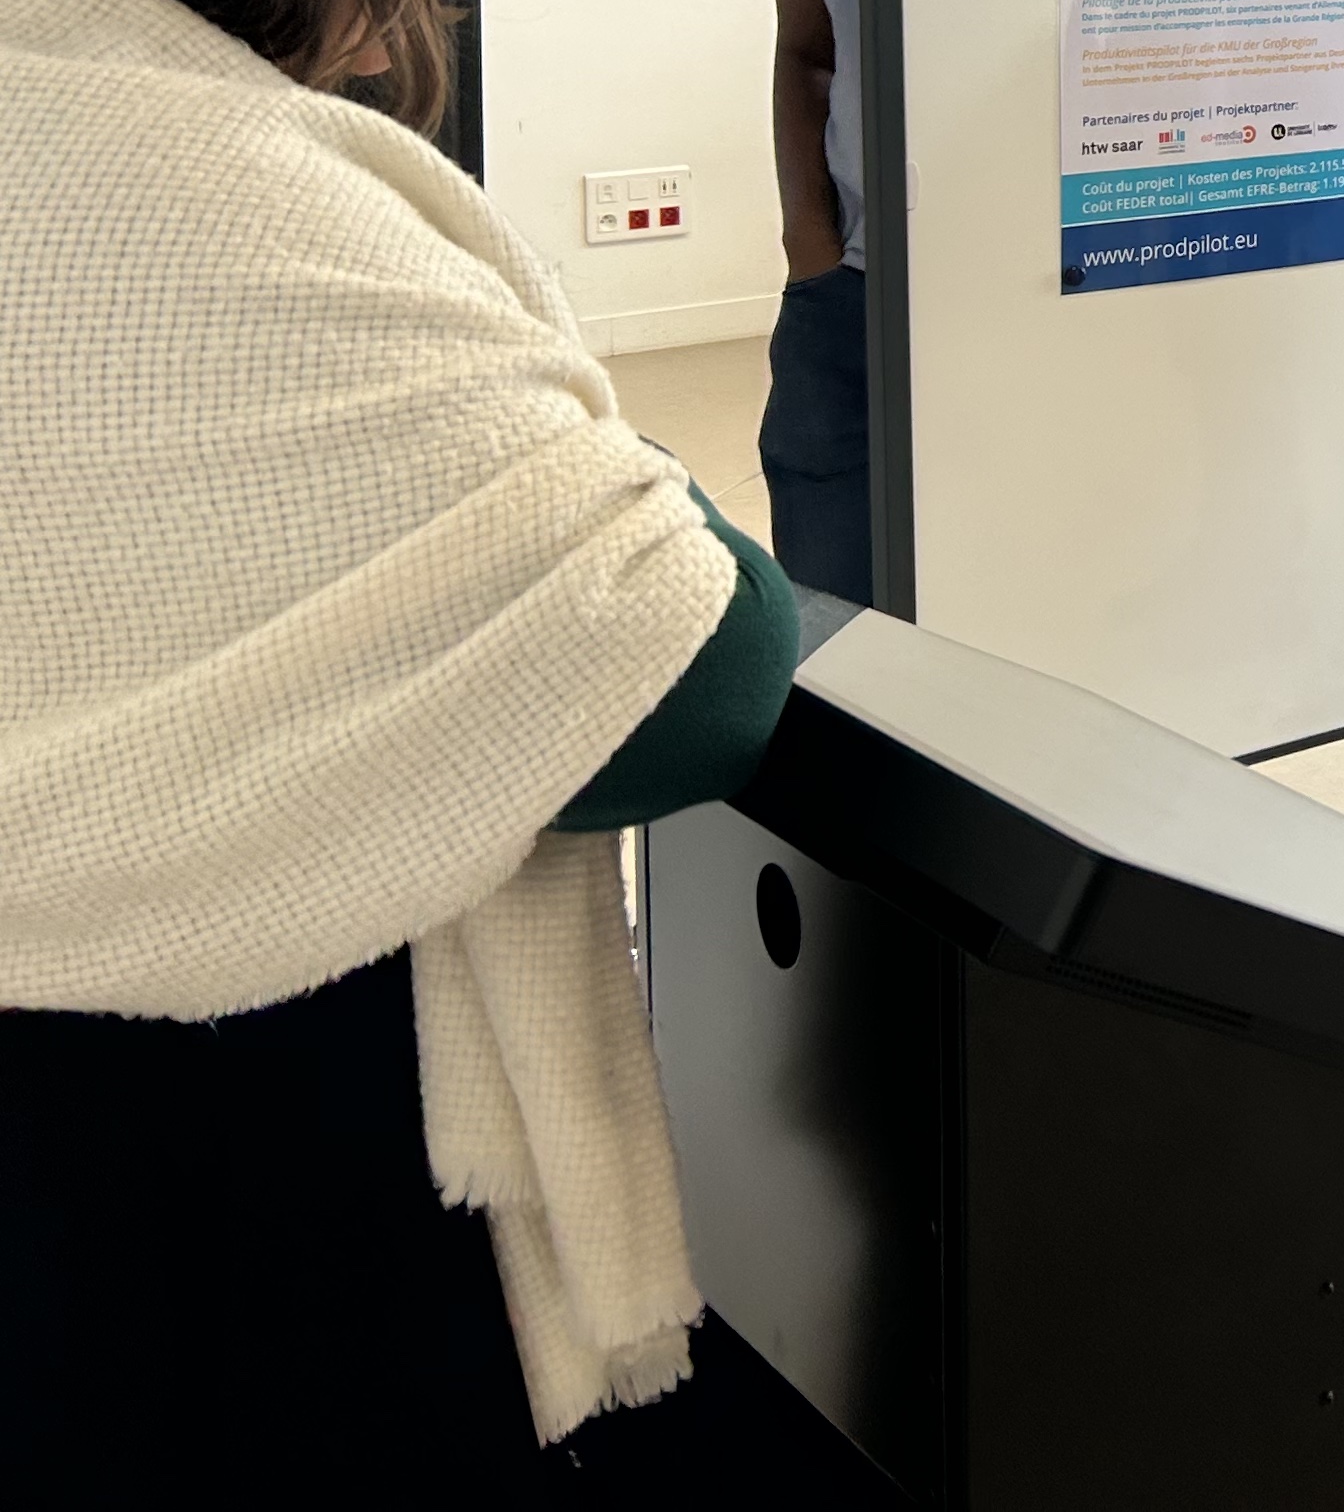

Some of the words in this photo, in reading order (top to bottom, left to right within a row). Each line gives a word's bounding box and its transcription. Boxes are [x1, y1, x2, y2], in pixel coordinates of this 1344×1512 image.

[1081, 26, 1096, 35] ont
[1098, 26, 1118, 36] pour
[1214, 19, 1226, 27] les
[1227, 16, 1270, 27] entreprises
[1272, 15, 1282, 24] de
[1283, 14, 1291, 23] la
[1292, 13, 1319, 23] Grande
[1082, 12, 1103, 22] Dans
[1104, 11, 1113, 20] le
[1114, 10, 1137, 20] cadre
[1139, 9, 1150, 19] du
[1151, 9, 1176, 20] projet
[1226, 5, 1237, 14] six
[1238, 3, 1282, 15] partenaires
[1082, 44, 1180, 61] Produktivitätspilot
[1181, 43, 1196, 57] für
[1199, 42, 1216, 53] die
[1217, 40, 1242, 51] KMU
[1243, 39, 1260, 50] der
[1262, 37, 1318, 51] Großregion
[1082, 111, 1150, 128] Partenaires
[1152, 109, 1168, 122] du
[1170, 107, 1205, 124] projet
[1215, 101, 1299, 118] Projektpartner:
[1081, 142, 1108, 156] htw
[1111, 139, 1143, 153] saar
[1082, 181, 1113, 196] Coût
[1115, 179, 1133, 193] du
[1135, 176, 1175, 193] projet
[1187, 172, 1229, 185] Kosten
[1231, 169, 1253, 181] des
[1255, 164, 1306, 180] Projekts:
[1082, 199, 1113, 214] Coût
[1116, 195, 1156, 210] FEDER
[1198, 187, 1244, 203] Gesamt
[1246, 180, 1321, 198] EFRE-Betrag:
[1083, 232, 1258, 267] www.prodpilot.eu
